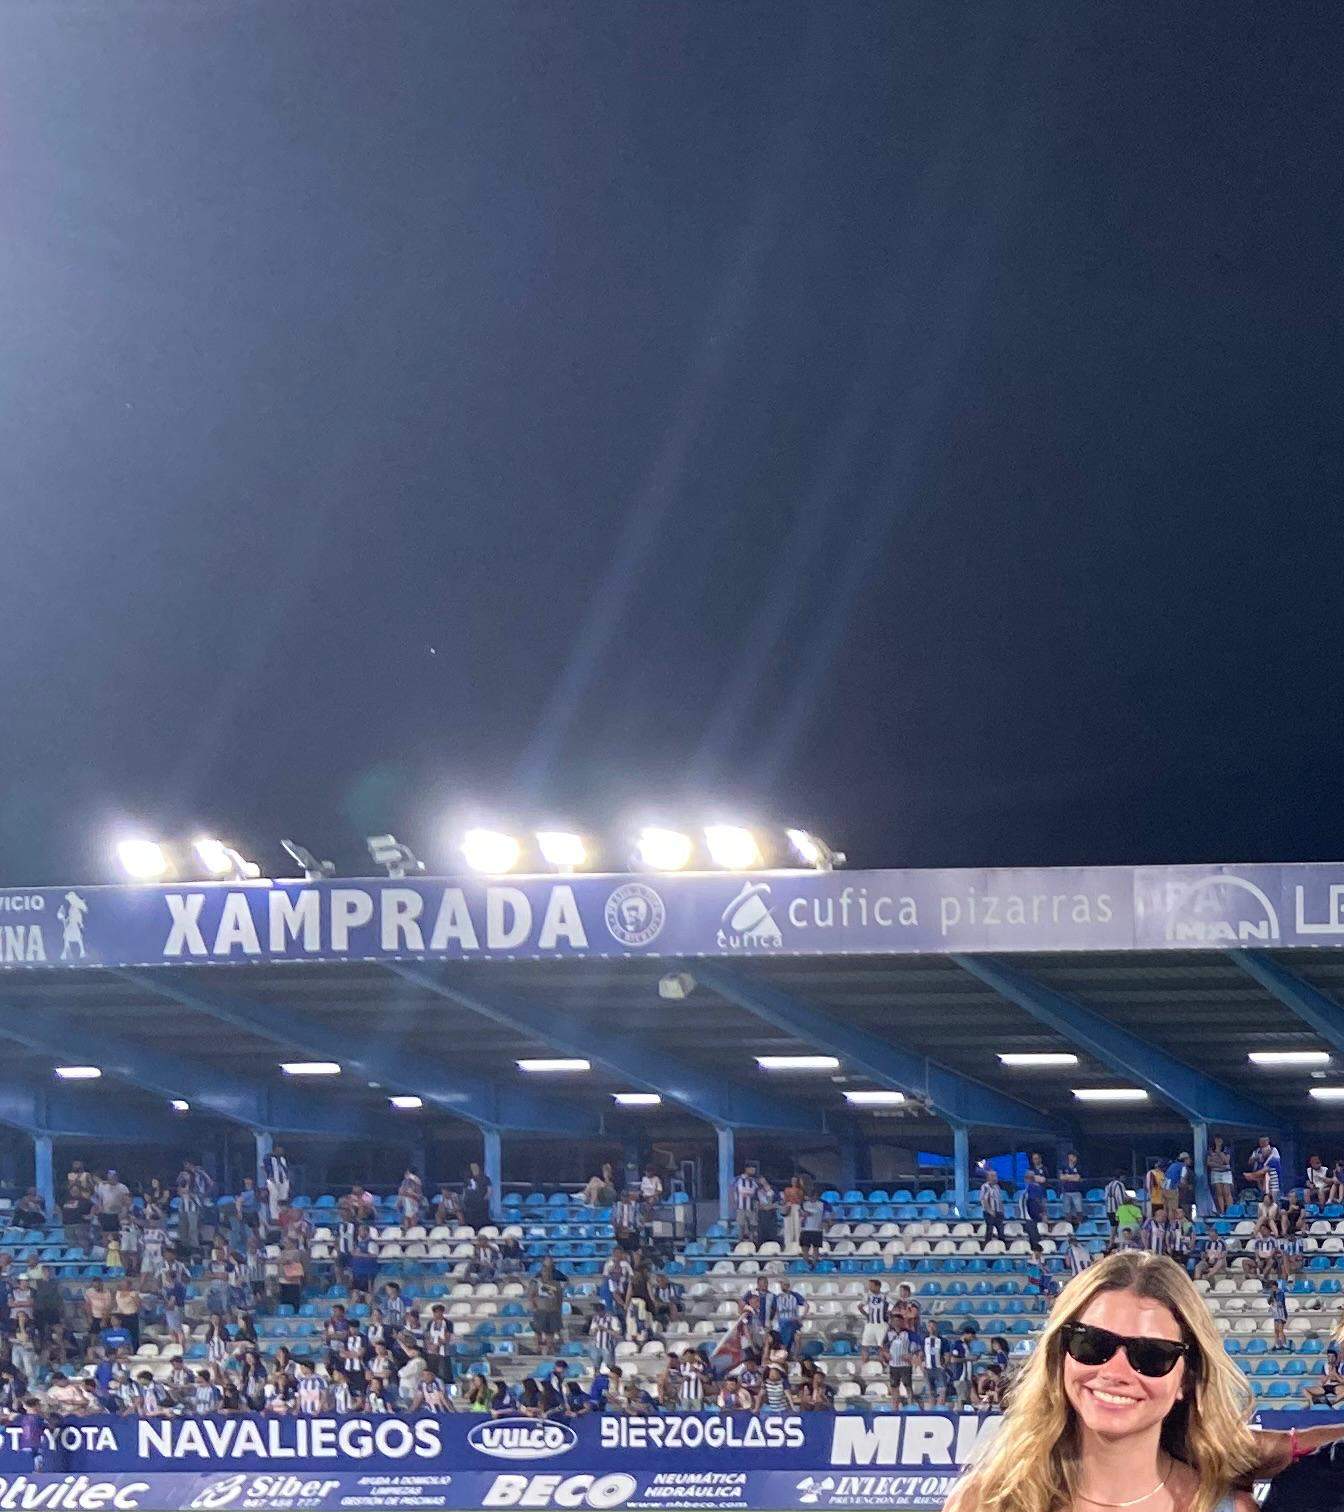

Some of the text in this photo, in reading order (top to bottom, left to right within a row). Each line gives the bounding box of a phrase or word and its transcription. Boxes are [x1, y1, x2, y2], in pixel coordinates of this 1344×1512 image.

[0, 895, 45, 911] ICIO
[788, 886, 919, 928] cufica
[939, 887, 1114, 937] pizarras
[163, 885, 589, 956] XAMPRADA
[0, 925, 47, 961] NA
[6, 1426, 118, 1451] TYOTA
[138, 1418, 442, 1459] NAVALIEGOS
[601, 1416, 805, 1449] BIERZOGLASS
[247, 1475, 341, 1497] Siber
[482, 1472, 637, 1510] BECO
[653, 1471, 748, 1485] NEUMÁTICA
